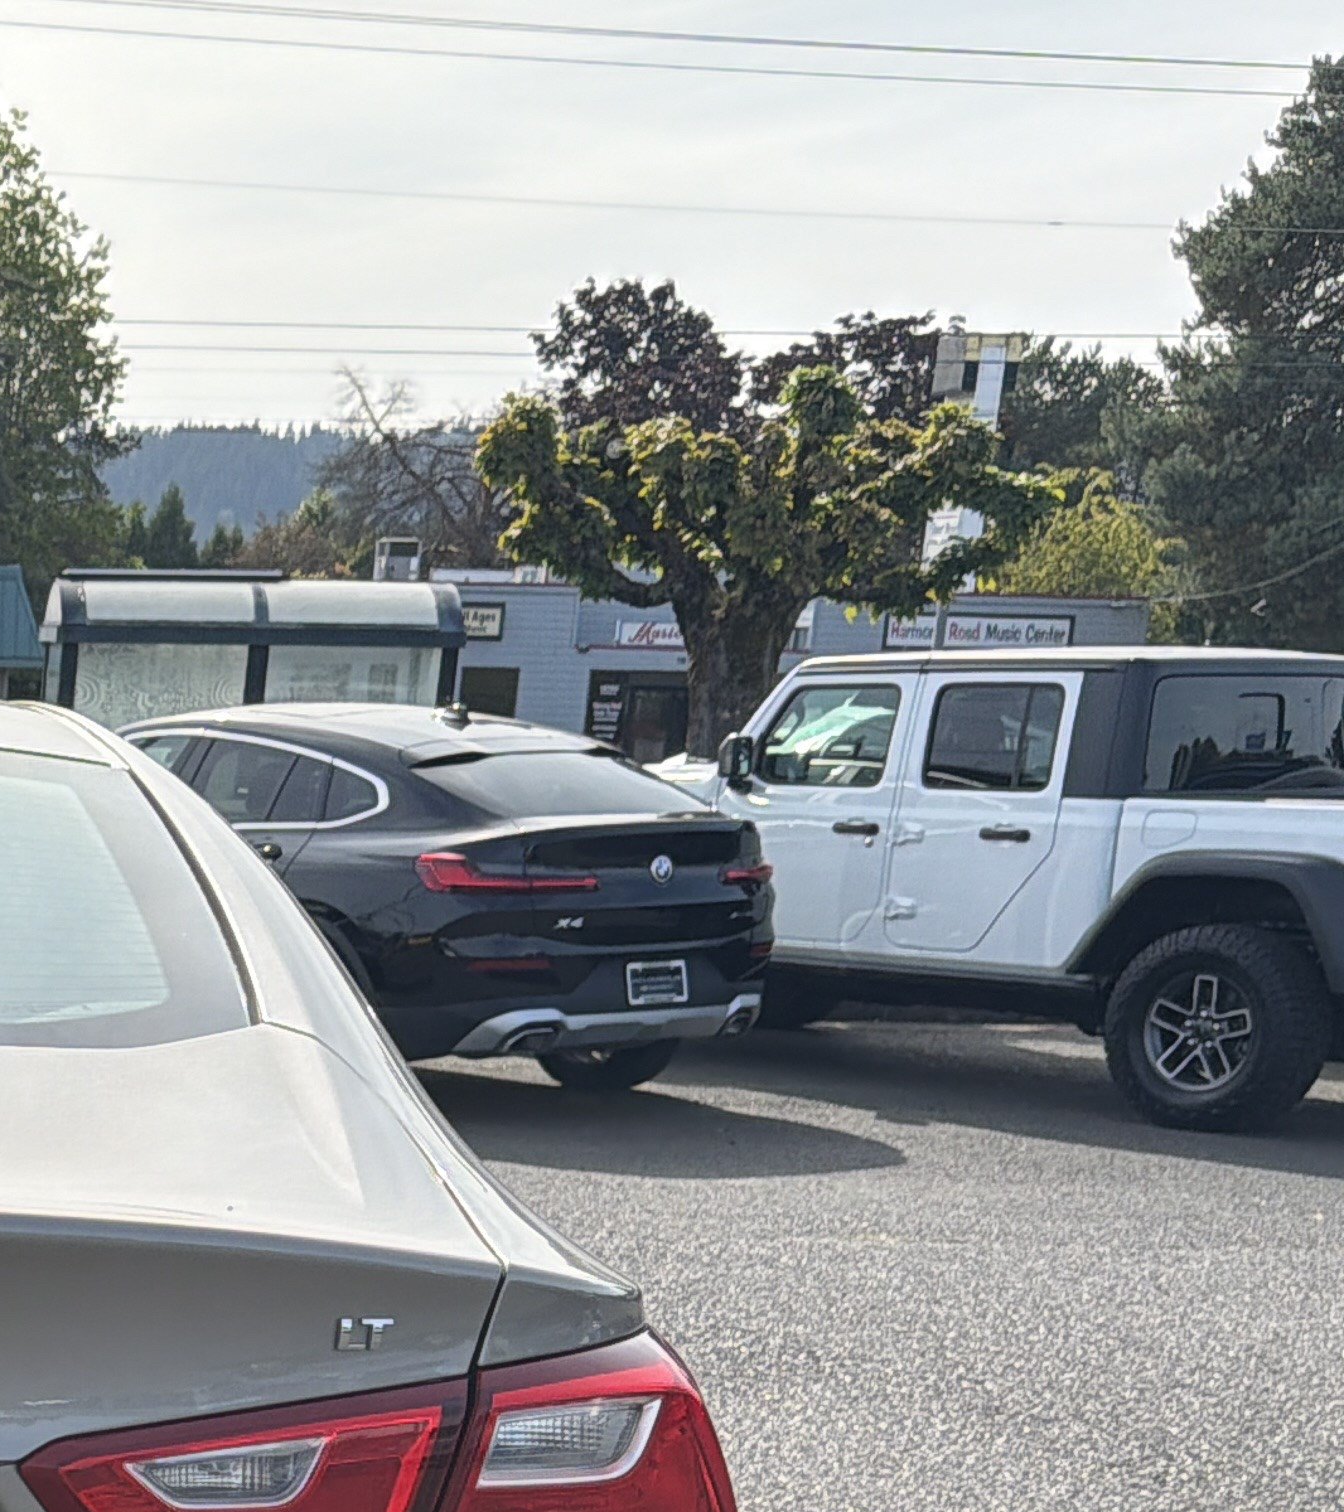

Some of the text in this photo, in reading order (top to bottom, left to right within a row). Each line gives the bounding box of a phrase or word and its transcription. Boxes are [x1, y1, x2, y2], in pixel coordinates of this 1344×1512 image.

[948, 622, 981, 641] Road
[985, 622, 1021, 642] Music
[1025, 623, 1066, 643] Center
[553, 916, 584, 929] X4
[335, 1318, 395, 1351] LT
